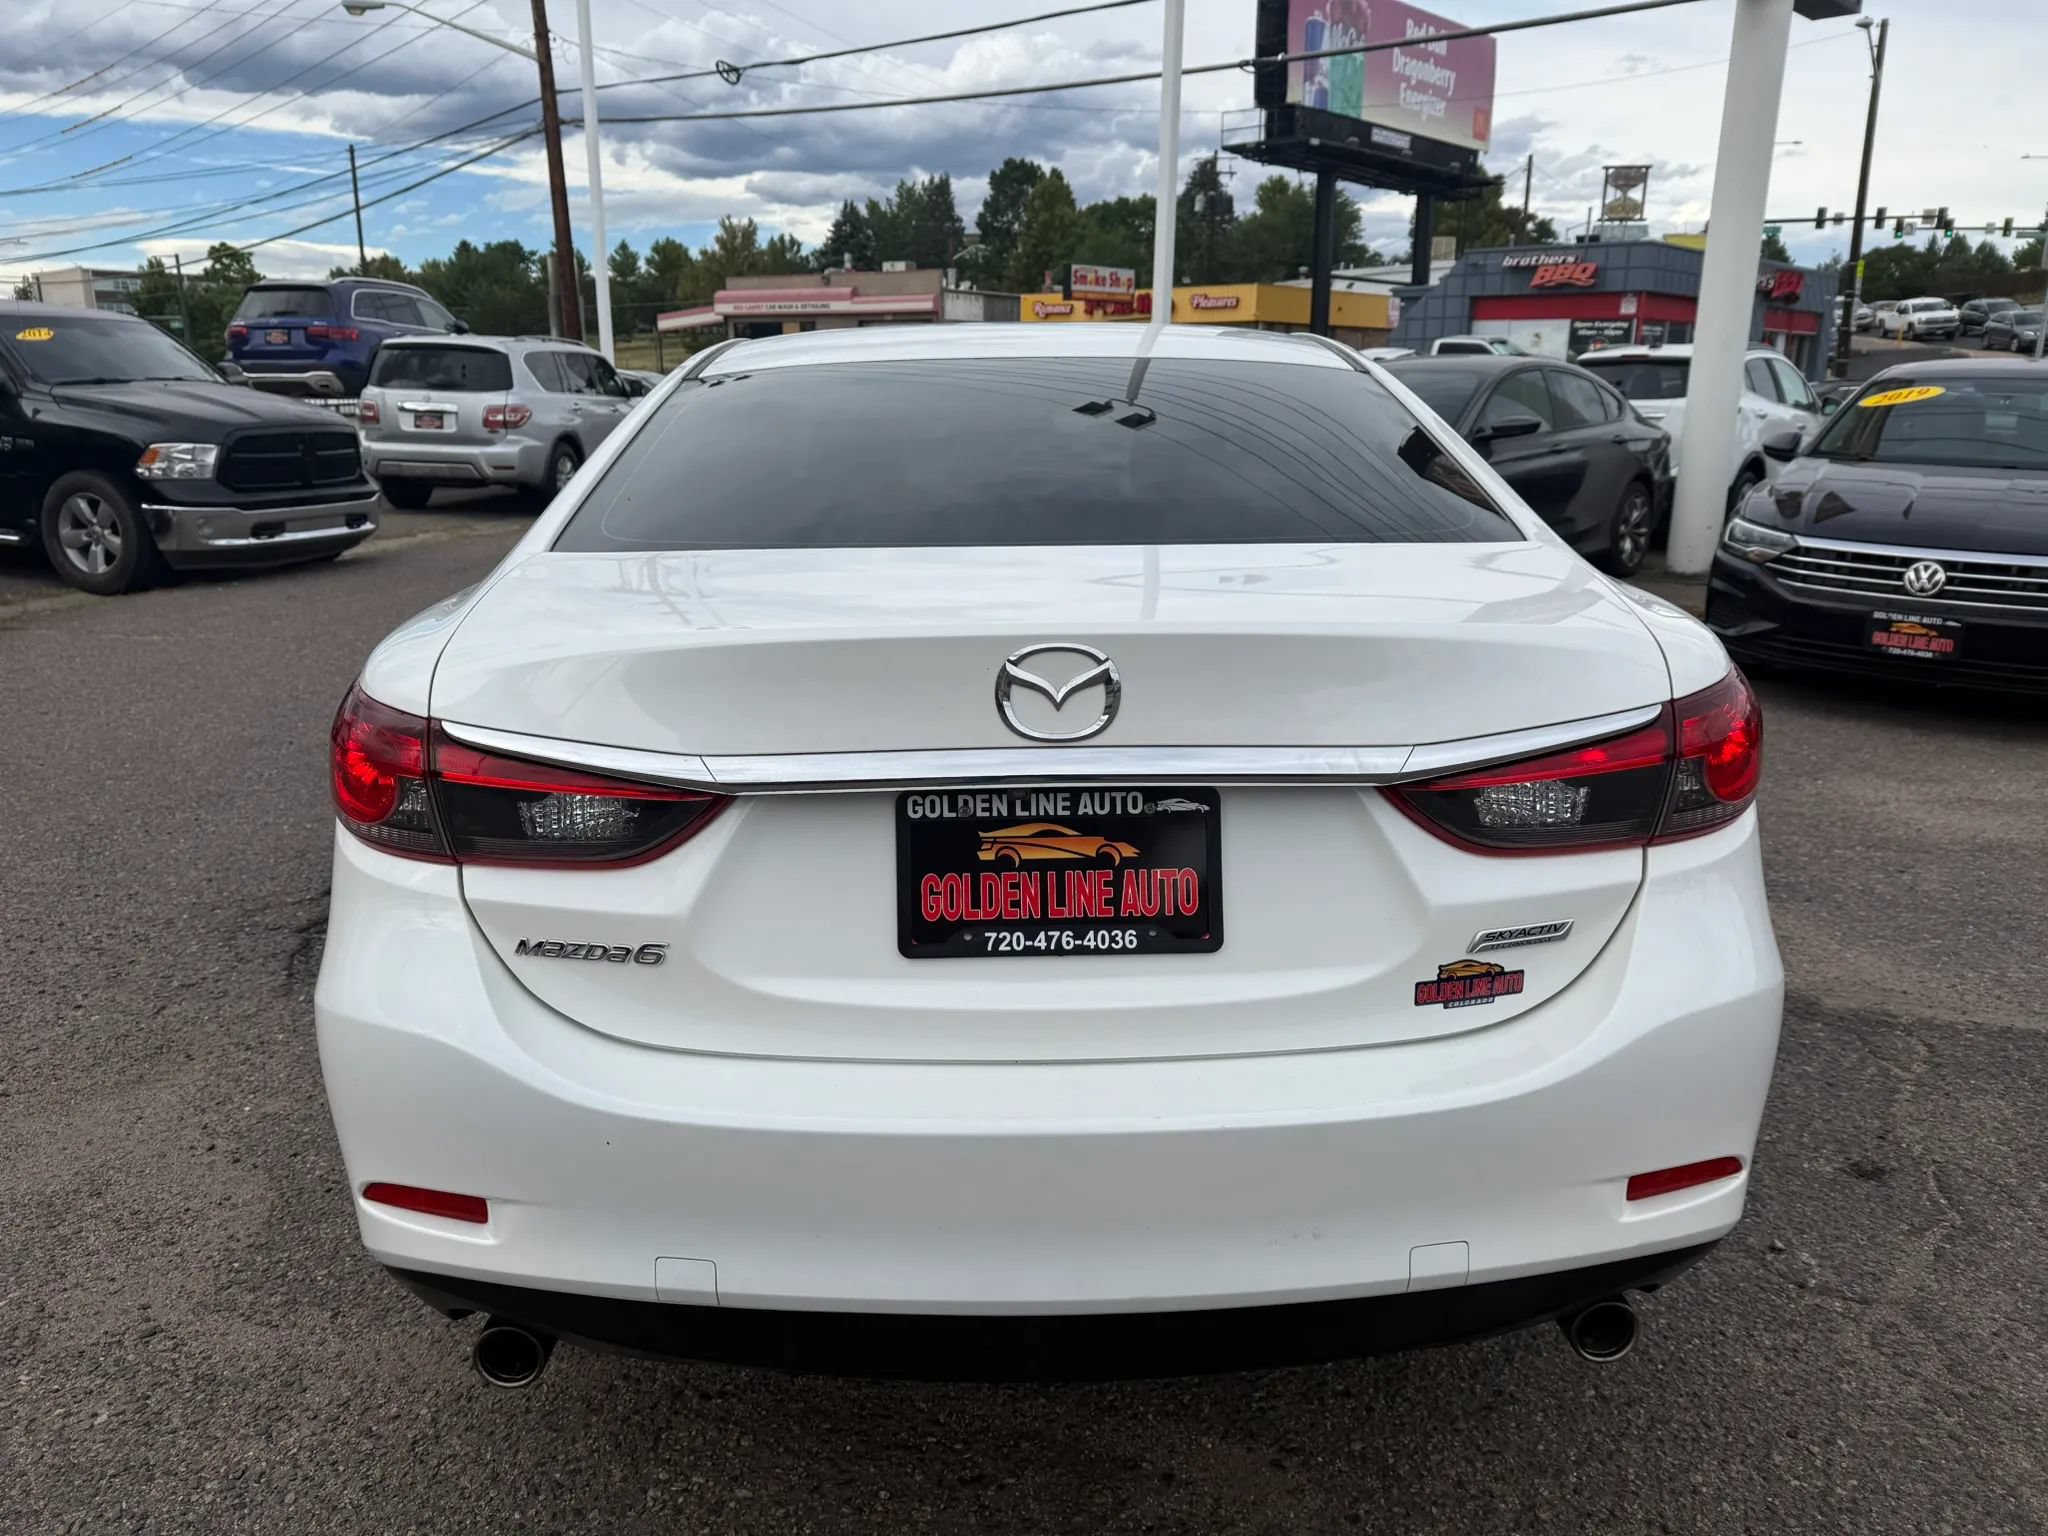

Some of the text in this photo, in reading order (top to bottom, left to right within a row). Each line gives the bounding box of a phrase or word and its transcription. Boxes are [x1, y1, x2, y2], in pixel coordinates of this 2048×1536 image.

[1392, 46, 1456, 96] Dragonberry
[1400, 82, 1446, 122] Energizer
[1501, 253, 1577, 267] brothers
[1073, 269, 1133, 291] Smoke Shop
[1528, 261, 1599, 288] BBQ
[1191, 294, 1237, 309] Pleasures
[1872, 388, 1931, 404] 2019
[1904, 614, 1921, 622] LINE
[1922, 616, 1943, 625] AUTO
[1909, 634, 1929, 650] LINE
[1929, 636, 1954, 653] AUTO
[906, 791, 1144, 819] GOLDEN LINE AUTO
[921, 867, 1199, 922] GOLDEN LINE AUTO
[984, 929, 1138, 951] 720-476-4036
[1484, 922, 1566, 942] SKYACTIV
[1417, 973, 1523, 1003] GOLDEN LINE AUTO
[1448, 997, 1495, 1008] COLORADO
